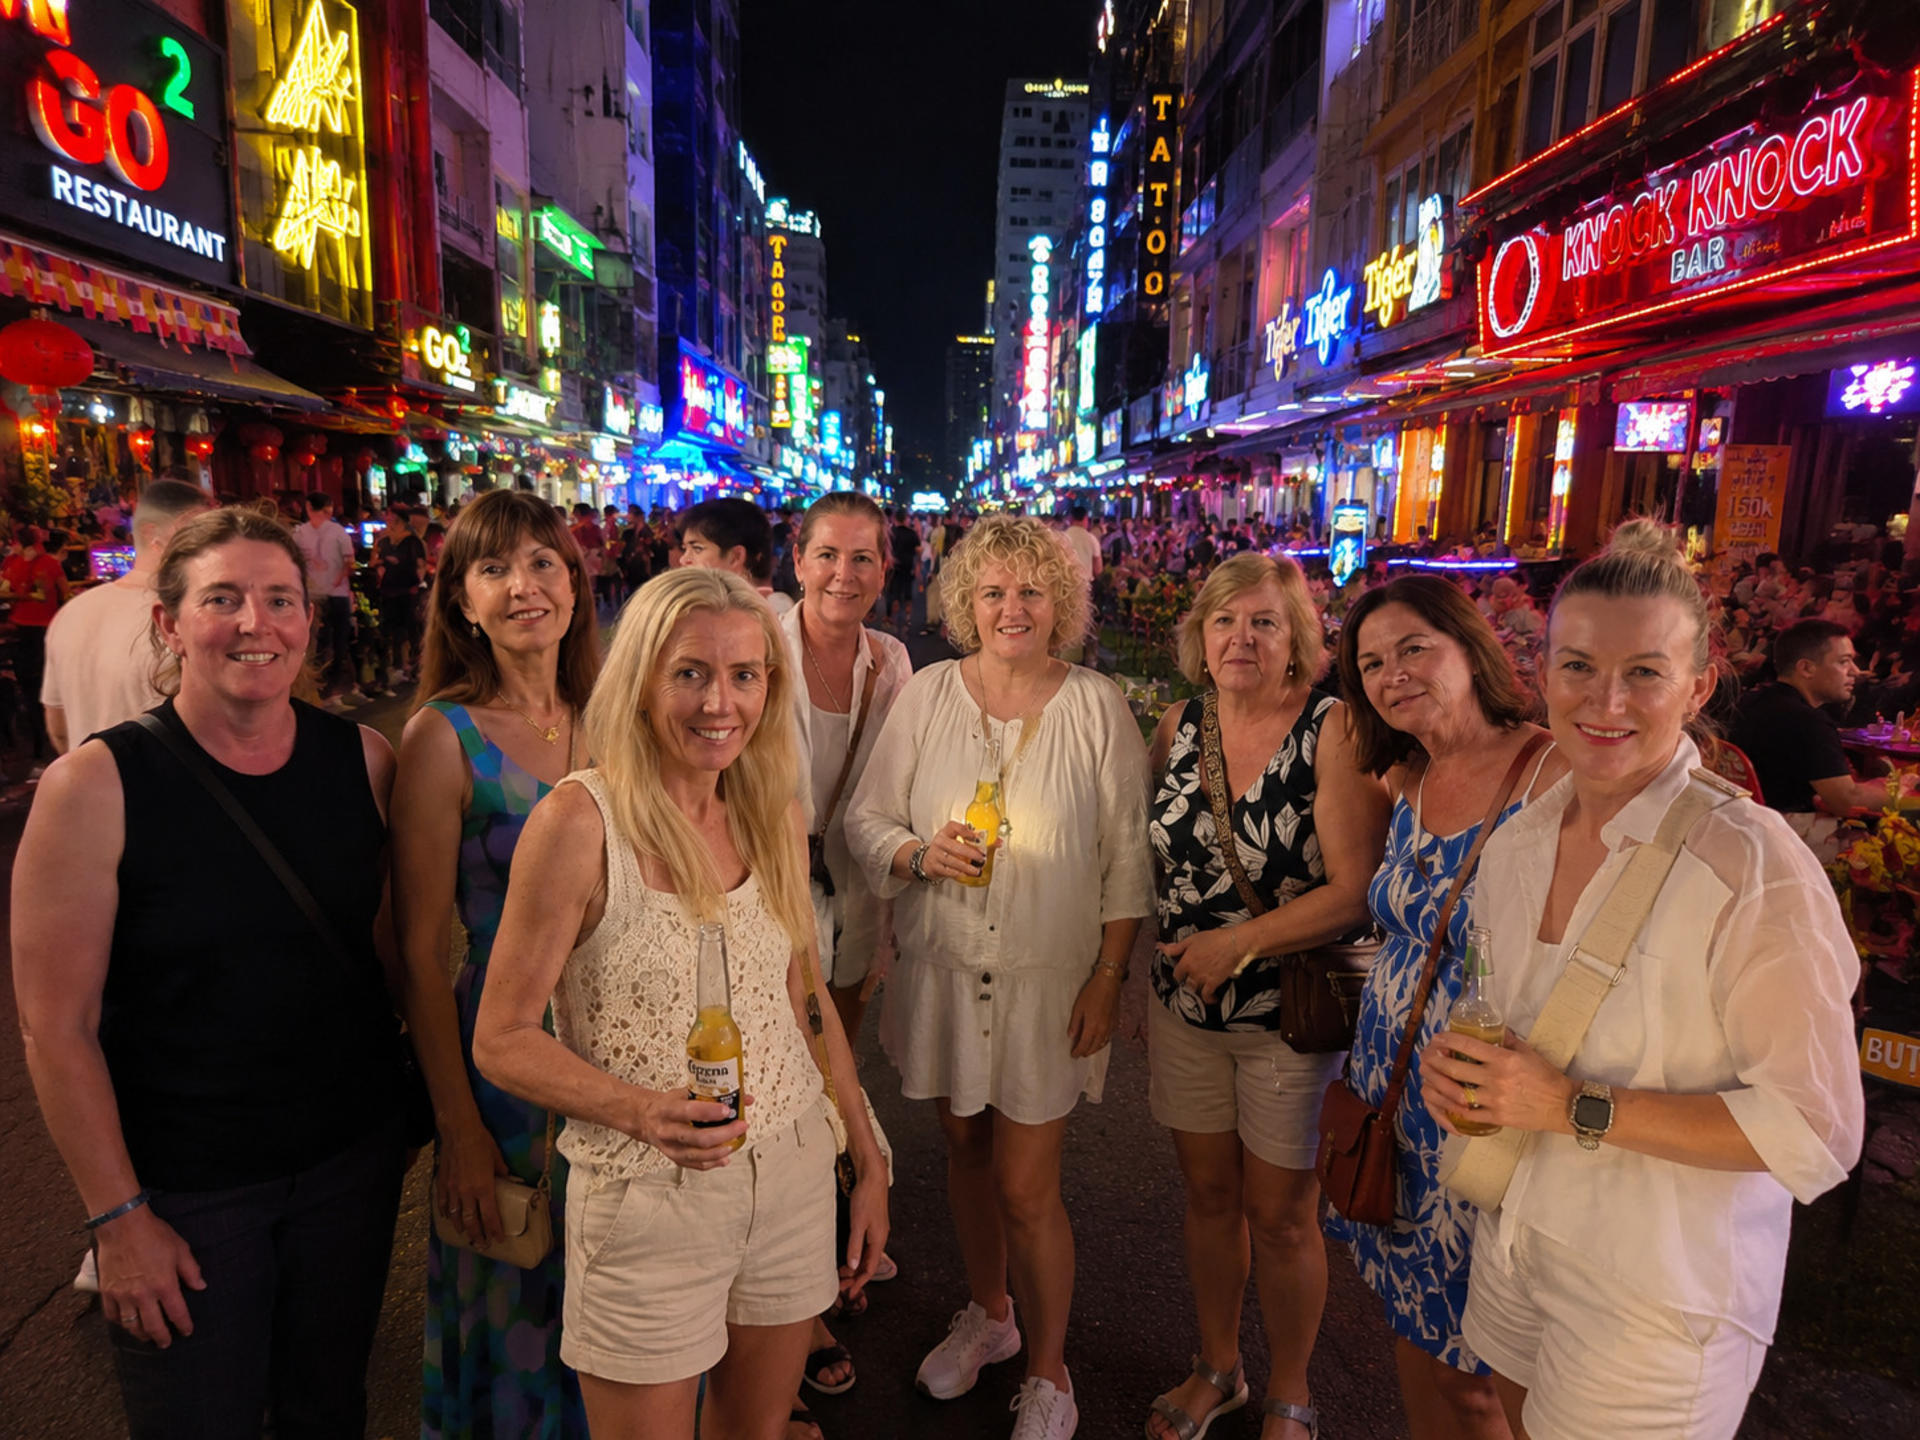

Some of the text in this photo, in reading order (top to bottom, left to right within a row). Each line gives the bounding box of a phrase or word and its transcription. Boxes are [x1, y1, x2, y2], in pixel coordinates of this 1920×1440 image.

[26, 48, 169, 191] GO
[161, 36, 195, 120] 2
[51, 165, 226, 262] RESTAURANT
[1562, 96, 1868, 281] KNOCK KNOCK
[1363, 244, 1418, 328] Tiger
[1670, 236, 1726, 284] BAR
[422, 325, 461, 374] GO
[456, 324, 472, 354] 2
[1265, 303, 1301, 382] Tiger
[1304, 268, 1352, 365] Tiger
